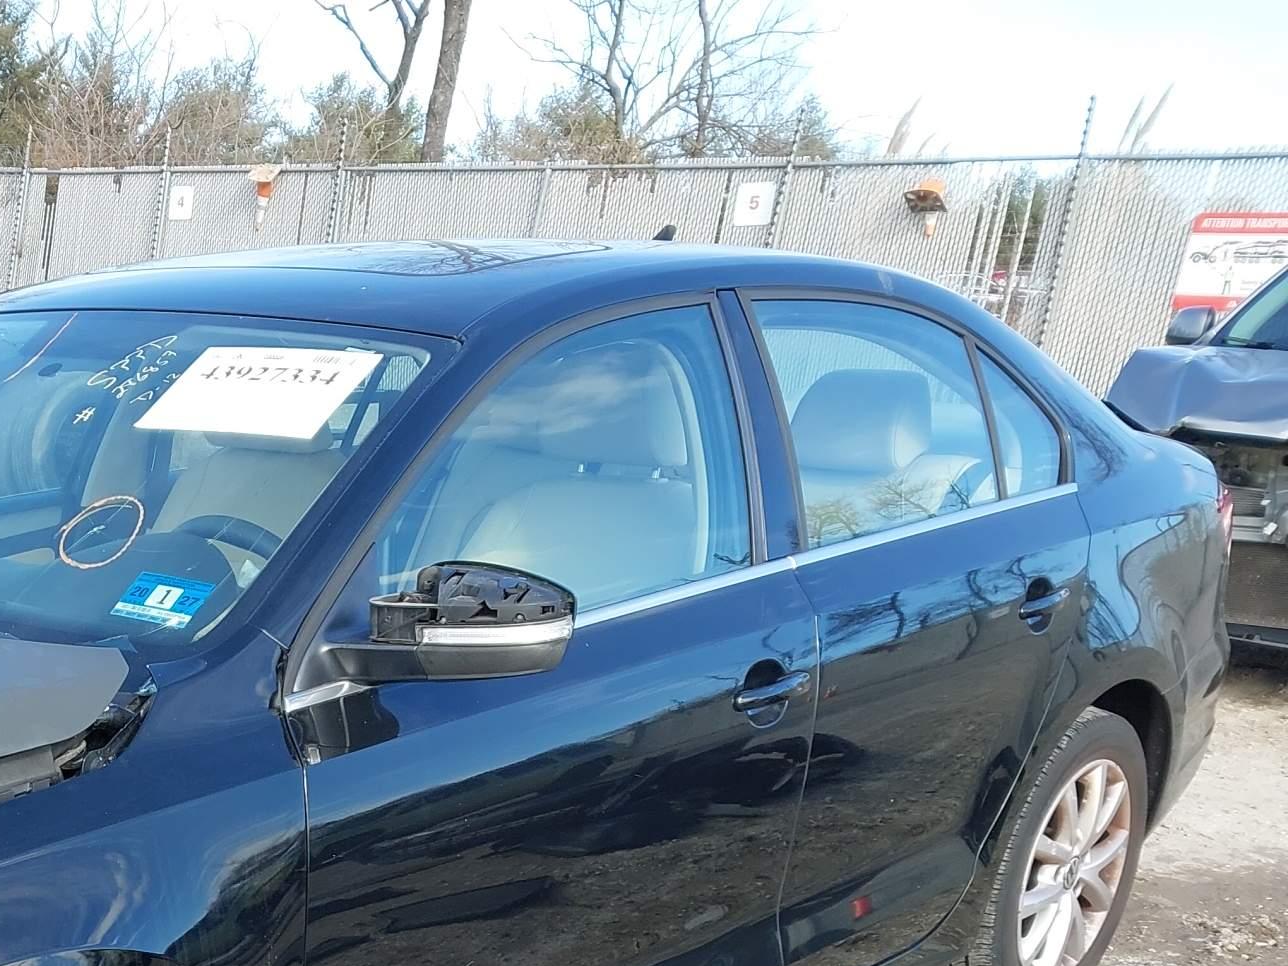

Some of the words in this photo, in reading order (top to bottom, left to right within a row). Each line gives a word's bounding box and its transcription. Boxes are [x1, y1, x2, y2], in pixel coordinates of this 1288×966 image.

[748, 194, 761, 210] 5
[1201, 217, 1244, 229] ATTENTION
[199, 365, 341, 386] 43927334
[129, 585, 150, 598] 20
[155, 588, 173, 606] 1
[177, 594, 201, 608] 27
